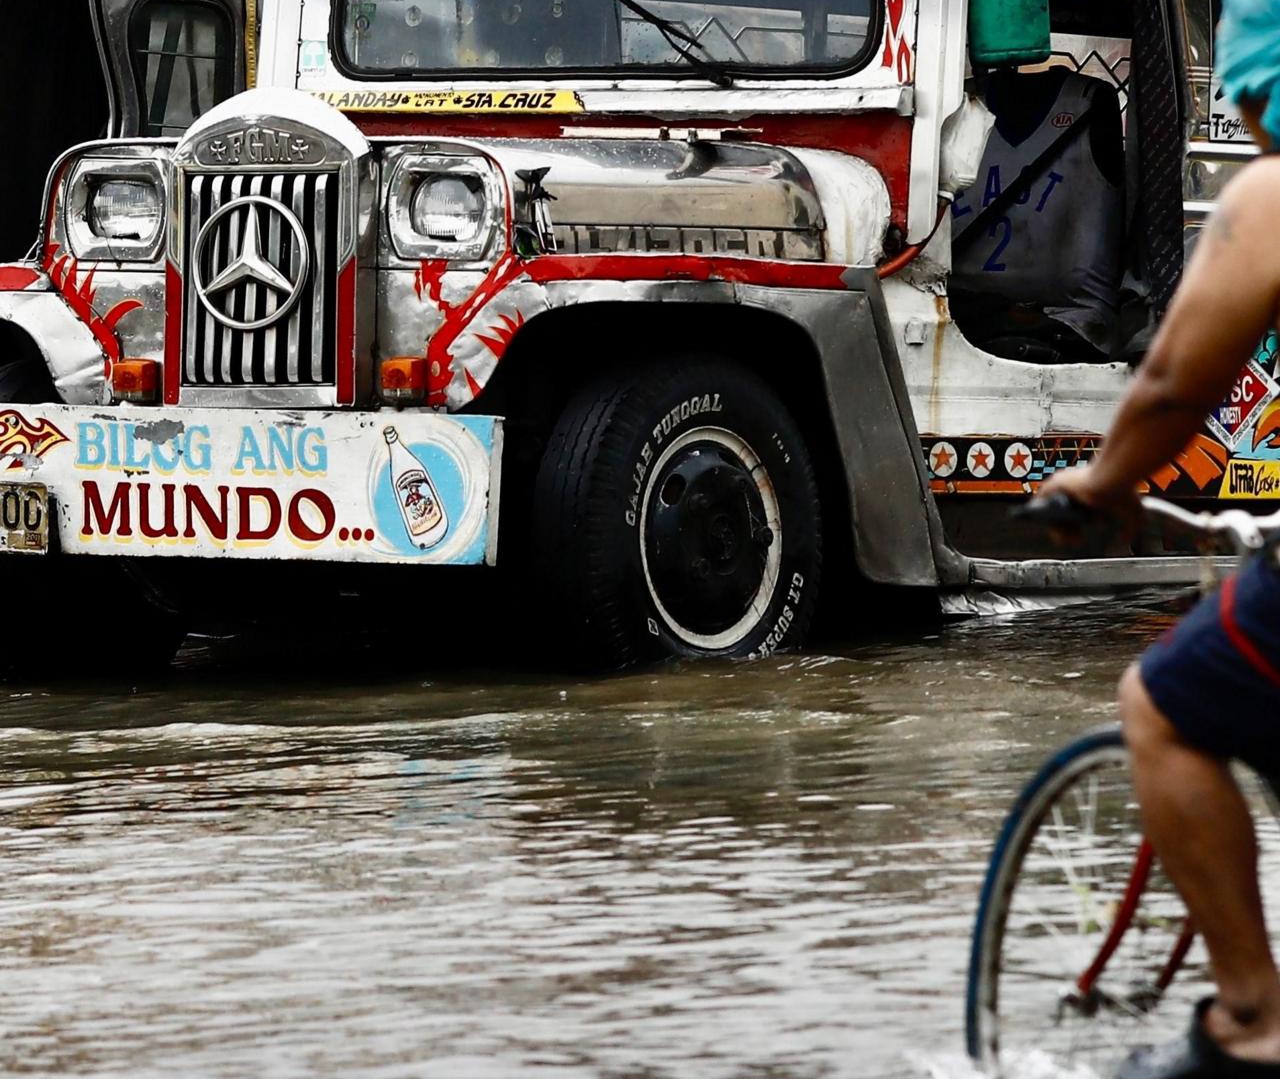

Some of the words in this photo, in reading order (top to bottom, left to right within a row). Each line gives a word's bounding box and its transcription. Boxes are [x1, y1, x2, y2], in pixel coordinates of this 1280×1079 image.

[462, 93, 498, 109] STA.
[499, 92, 557, 109] CRUZ
[226, 126, 292, 164] FGM
[981, 215, 1013, 273] 2
[1229, 375, 1254, 403] SC
[1219, 406, 1242, 425] HONESTY
[233, 425, 329, 473] ANG
[81, 480, 376, 542] MUNDO...
